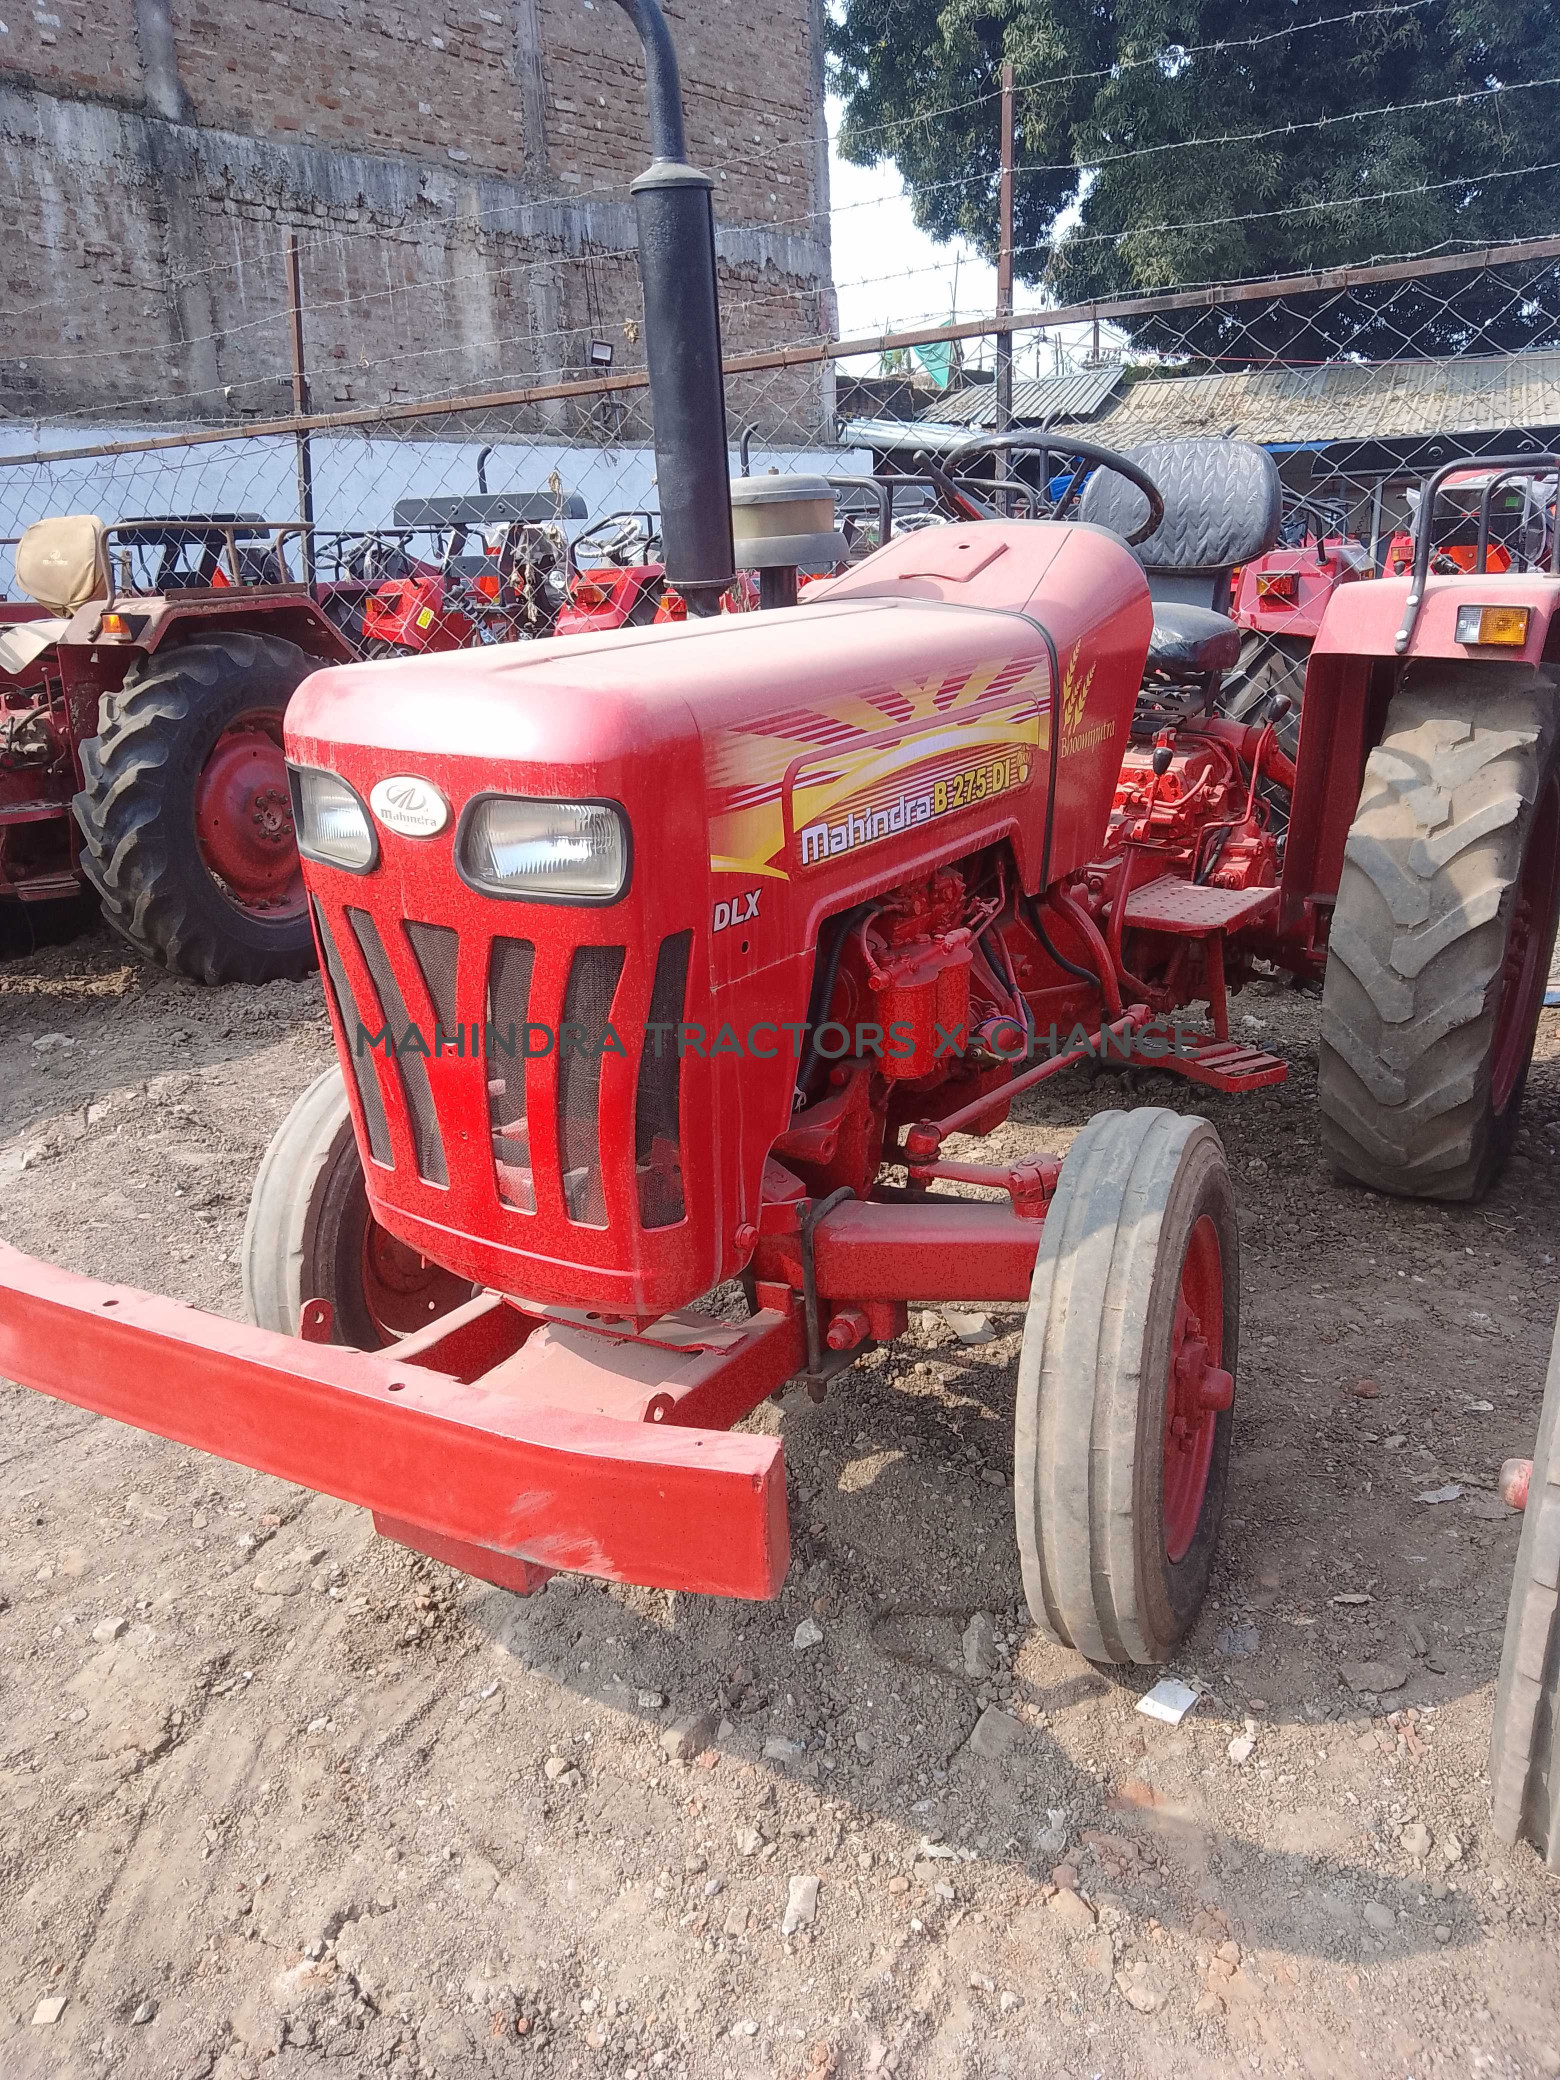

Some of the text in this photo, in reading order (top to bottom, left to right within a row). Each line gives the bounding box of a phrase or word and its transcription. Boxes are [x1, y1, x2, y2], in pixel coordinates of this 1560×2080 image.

[1061, 720, 1115, 758] Bhoomiputra
[381, 808, 436, 827] Mahindra
[801, 796, 931, 865] Mahindra
[933, 783, 948, 815] B
[953, 766, 987, 807] 275
[991, 758, 1011, 795] DI
[713, 889, 761, 934] DLX
